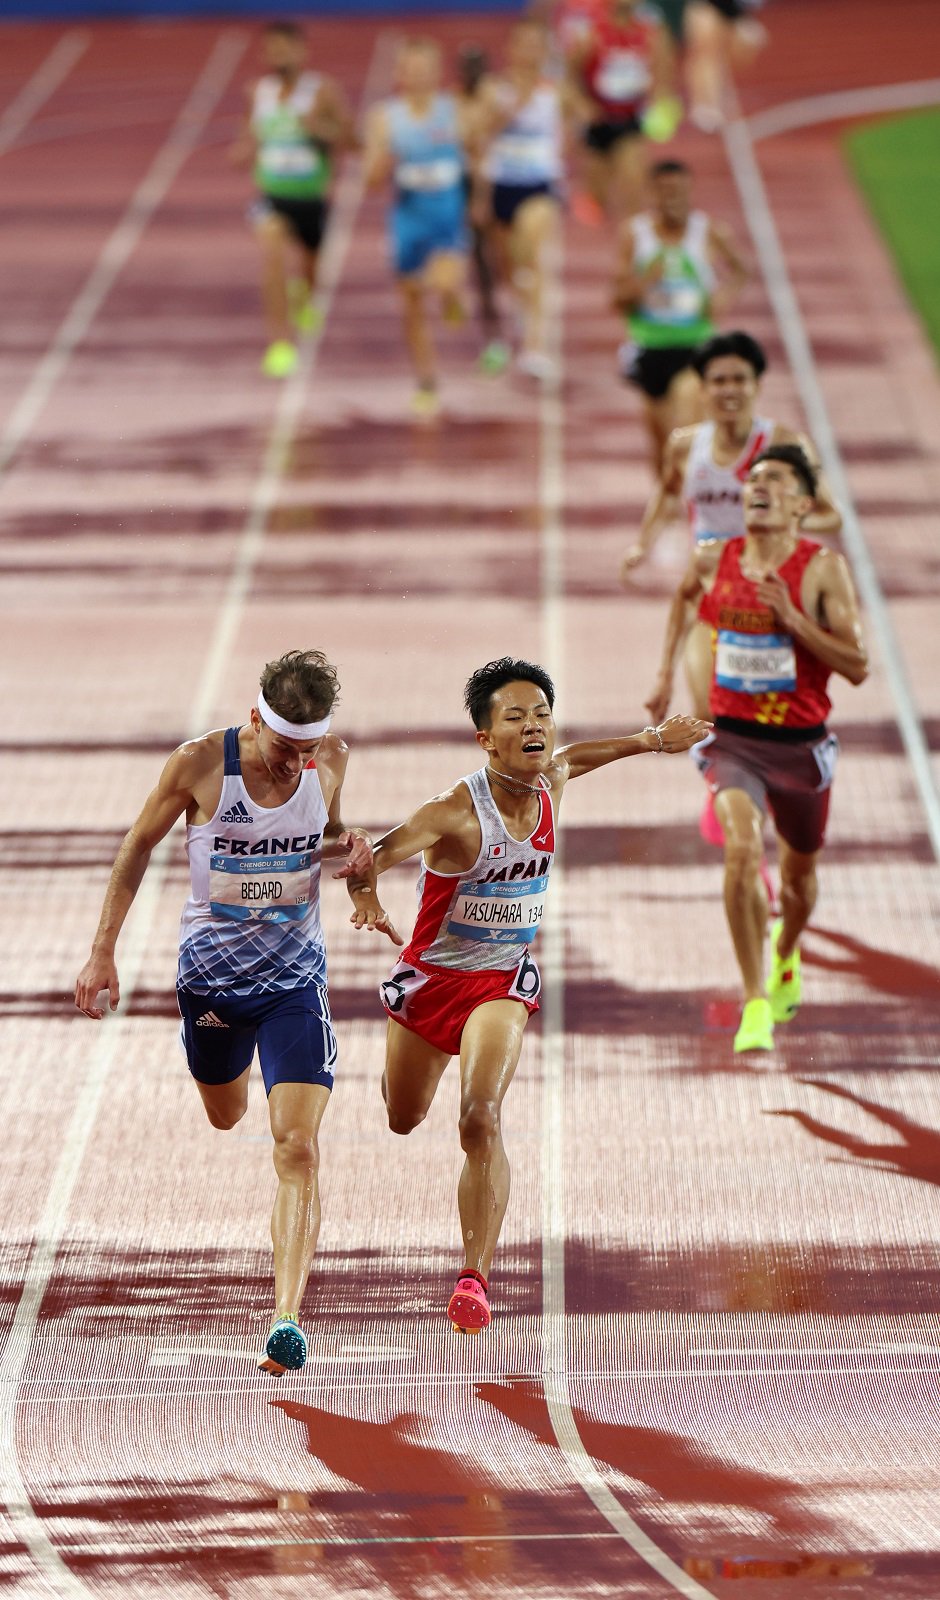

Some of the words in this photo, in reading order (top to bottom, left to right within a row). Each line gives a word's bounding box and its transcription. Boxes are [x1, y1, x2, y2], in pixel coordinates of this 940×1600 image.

[220, 814, 254, 824] adidas
[213, 832, 322, 856] FRANCE
[239, 860, 272, 868] CHENGDU
[476, 855, 551, 884] JAPAN
[241, 881, 283, 900] BEDARD
[295, 896, 306, 905] 1234
[463, 902, 522, 923] YASUHARA
[528, 905, 544, 924] 134
[195, 1020, 230, 1028] adidas
